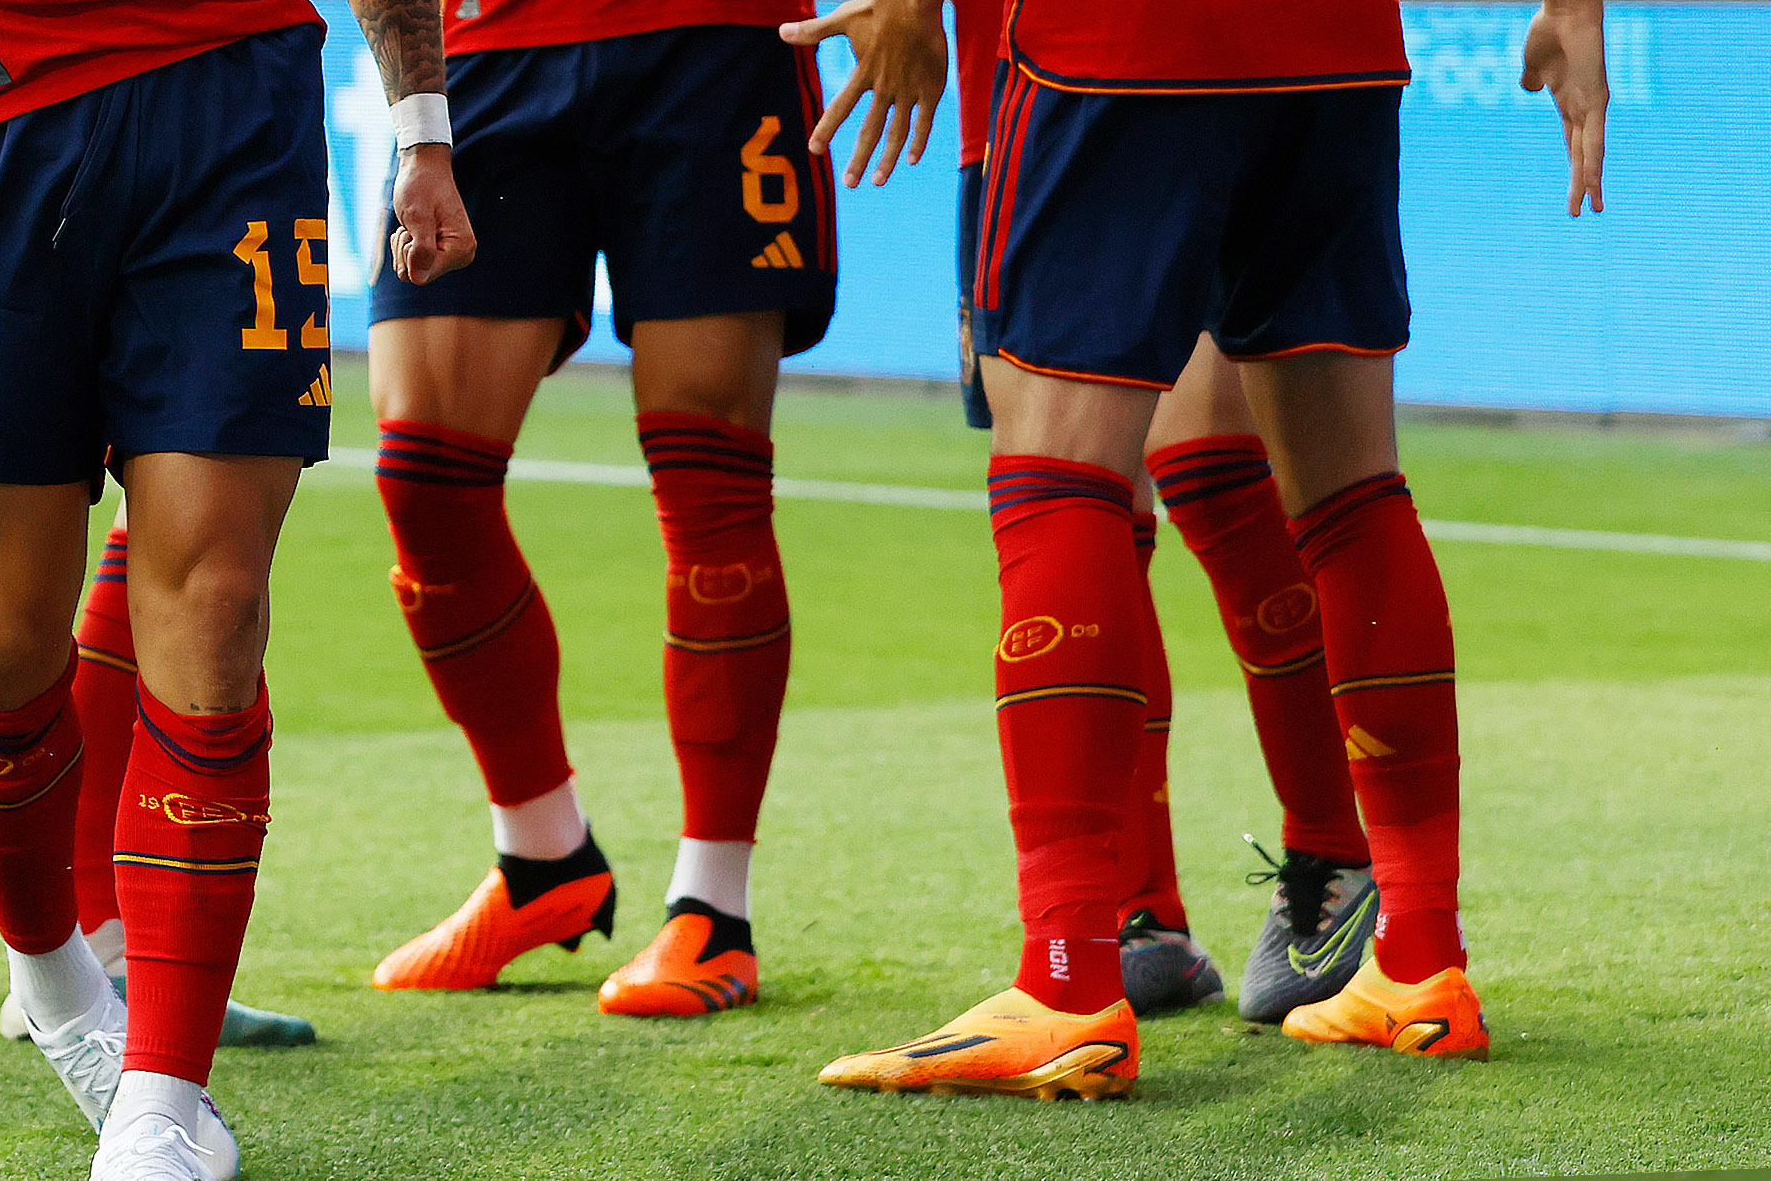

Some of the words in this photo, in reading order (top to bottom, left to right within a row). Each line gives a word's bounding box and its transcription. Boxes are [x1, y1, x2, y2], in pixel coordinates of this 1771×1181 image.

[740, 115, 799, 223] 6
[232, 218, 329, 350] 15
[138, 793, 160, 810] 19
